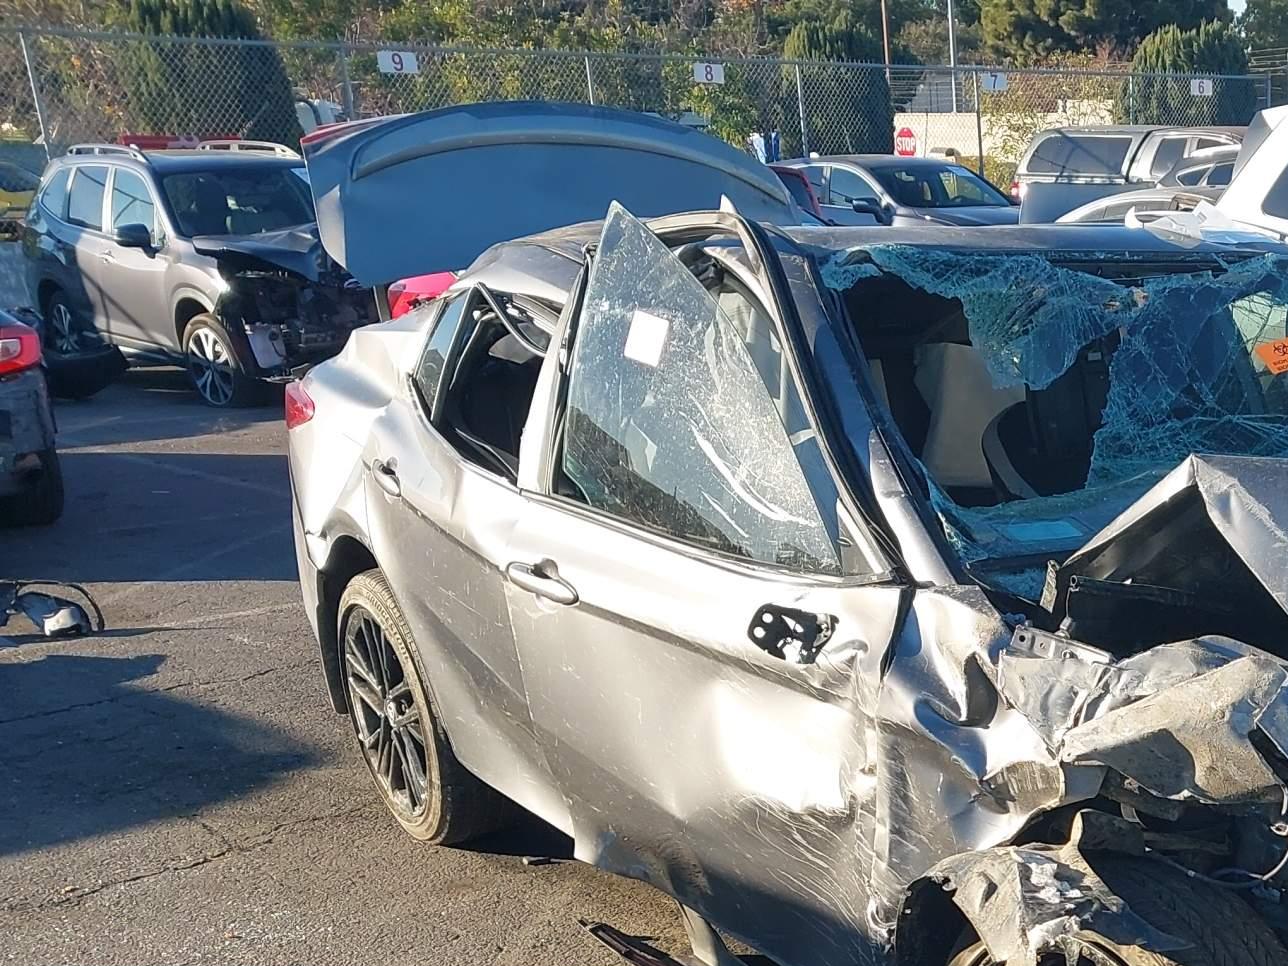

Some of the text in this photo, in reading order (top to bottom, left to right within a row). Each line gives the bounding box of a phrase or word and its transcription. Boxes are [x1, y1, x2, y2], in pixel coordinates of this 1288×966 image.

[391, 52, 404, 71] 9
[705, 65, 713, 81] 8
[991, 74, 998, 89] 7
[1198, 80, 1205, 95] 6
[896, 136, 916, 152] STOP
